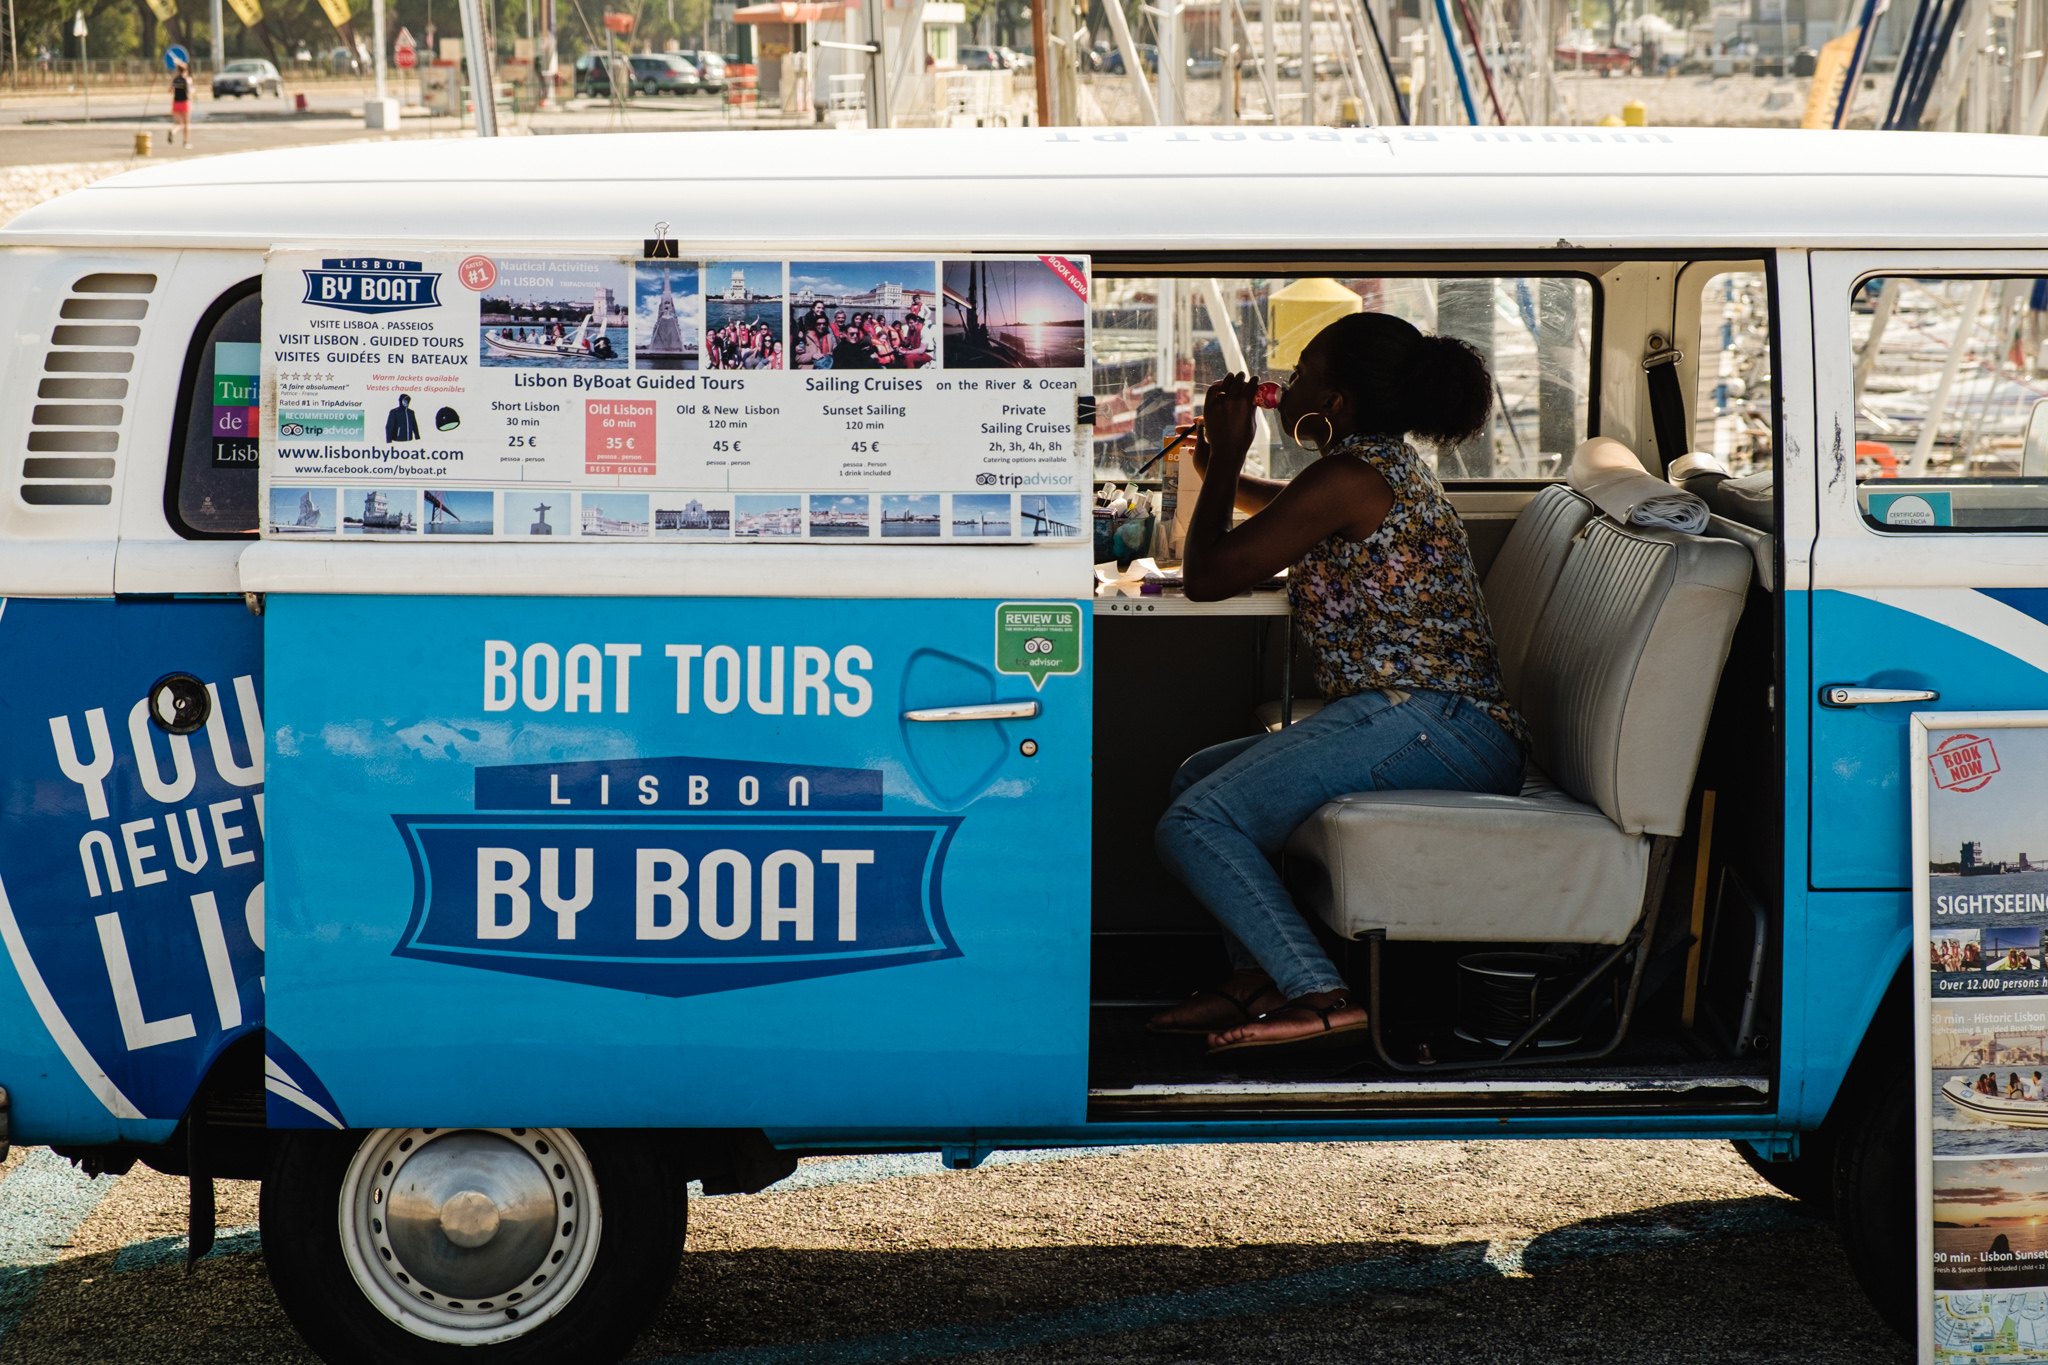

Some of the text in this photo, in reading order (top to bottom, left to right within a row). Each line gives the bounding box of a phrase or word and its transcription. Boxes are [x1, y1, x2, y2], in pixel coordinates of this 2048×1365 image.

[340, 260, 405, 270] LISBON
[465, 260, 484, 270] RATED
[500, 261, 599, 273] Nautical Activities
[468, 268, 489, 284] #1
[500, 276, 554, 287] in LISBON
[1048, 256, 1088, 295] BOOK NOW
[322, 276, 421, 302] BY BOAT
[310, 320, 434, 331] VISITE LISBOA PASSEIOS
[279, 334, 464, 348] VISIT LISBON GUIDED TOURS
[275, 350, 468, 365] VISITES GUIDÉES EN BATEAUX
[397, 374, 424, 382] Jackets
[425, 375, 459, 383] available
[514, 373, 745, 391] Lisbon ByBoat Guided Tours
[366, 384, 466, 394] Vestes chaudes disponibles
[806, 377, 923, 394] Sailing Cruises
[936, 379, 1077, 391] on the River & Ocean
[320, 400, 363, 408] TripAdvisor
[491, 401, 560, 412] Short Lisbon
[589, 404, 653, 416] Old Lisbon
[676, 405, 780, 415] Old & New Lisbon
[1002, 404, 1046, 415] Private
[285, 412, 344, 420] RECOMMENDED
[822, 404, 906, 418] Sunset Sailing
[219, 412, 243, 431] de
[506, 418, 540, 426] 30 min
[602, 419, 637, 428] 60 min
[709, 420, 748, 429] 120 min
[846, 421, 885, 430] 120 min
[305, 425, 361, 436] tripadvisor
[981, 422, 1071, 436] Sailing Cruises
[508, 436, 537, 448] 25 €
[606, 437, 635, 450] 35 €
[712, 441, 742, 452] 45 €
[851, 441, 880, 453] 45 €
[989, 442, 1062, 453] 2h, 3h, 4h, 8h
[278, 445, 464, 463] www.lisbonbyboat.com
[295, 464, 447, 476] www.facebook.com/byboat.pt
[999, 472, 1073, 488] tripadvisor
[1006, 614, 1072, 624] REVIEW US
[483, 639, 874, 717] BOAT TOURS
[1942, 745, 1982, 769] BOOK
[1950, 760, 1983, 782] NOW
[550, 774, 810, 806] LISBON
[78, 793, 265, 898] NEVE
[476, 846, 875, 941] BY BOAT
[1936, 893, 2048, 915] SIGHTSEEIN
[1940, 978, 2039, 991] Over 12.000 persons
[1944, 1011, 2046, 1024] min Historic Lisbon
[1983, 1025, 2009, 1035] guided
[1934, 1252, 1947, 1263] 90
[1950, 1252, 1971, 1263] min
[1980, 1251, 2013, 1262] Lisbon
[1977, 1265, 1992, 1273] drink
[2021, 1263, 2034, 1271] child
